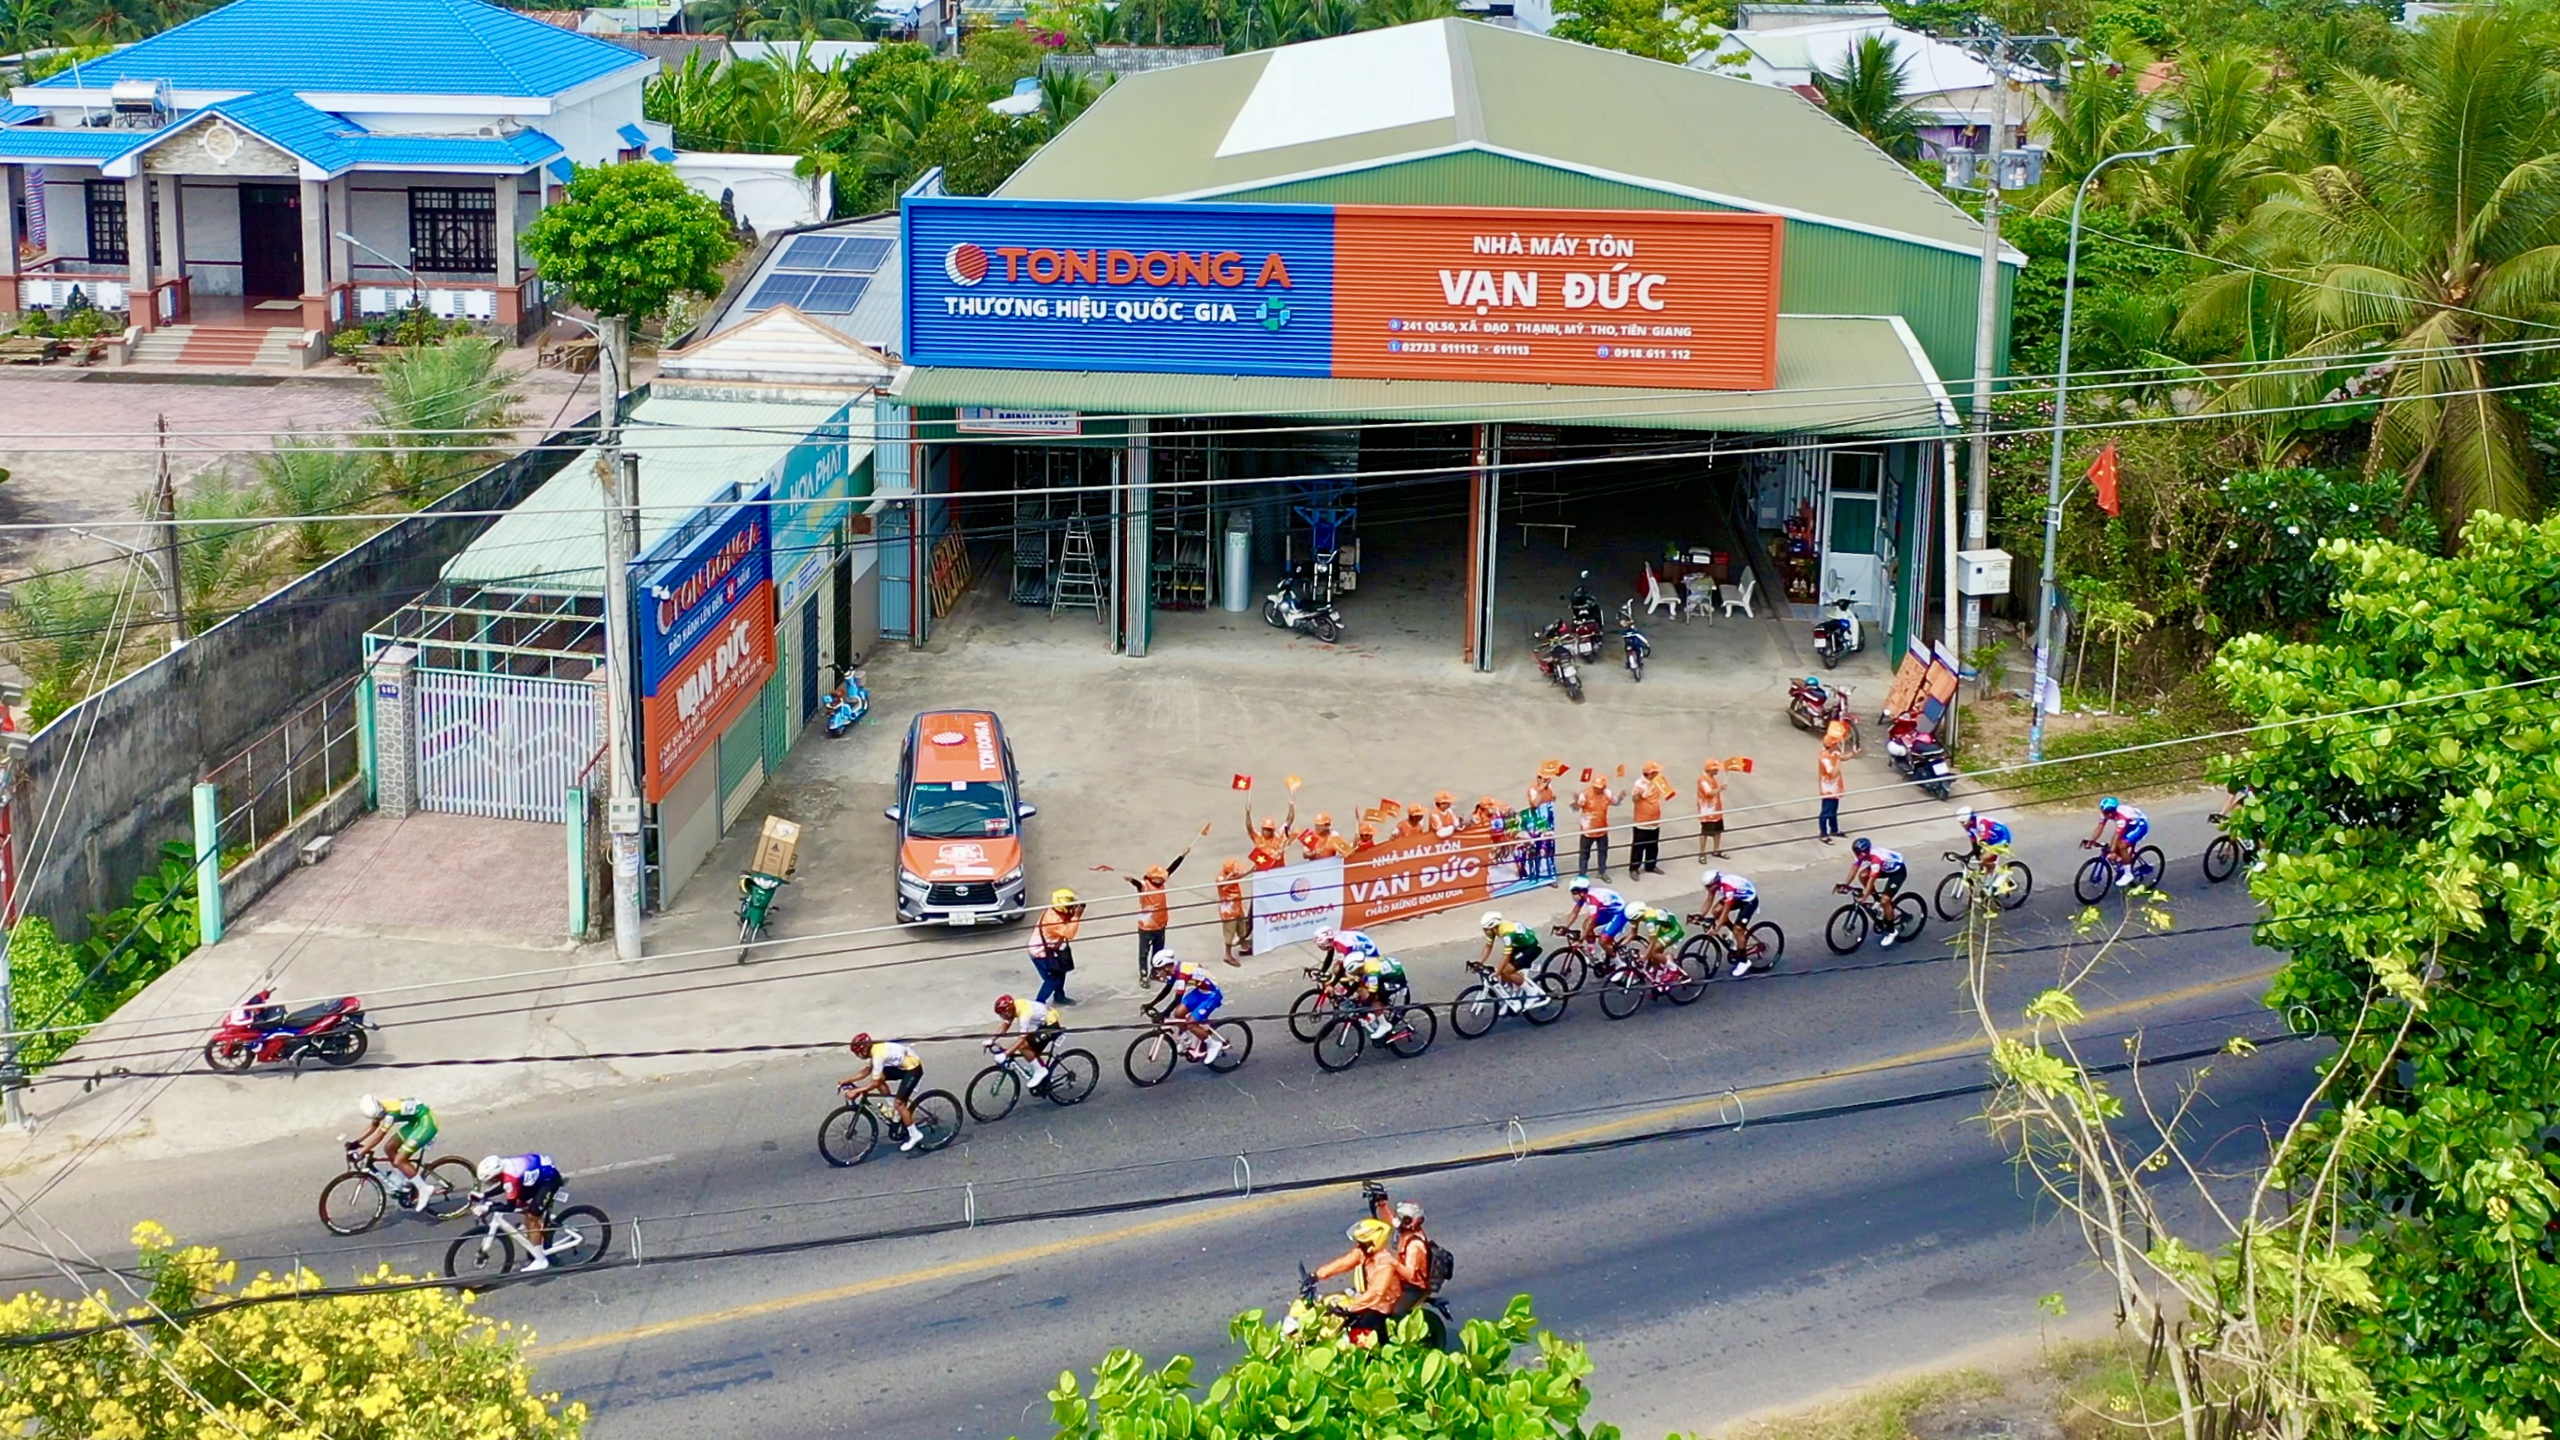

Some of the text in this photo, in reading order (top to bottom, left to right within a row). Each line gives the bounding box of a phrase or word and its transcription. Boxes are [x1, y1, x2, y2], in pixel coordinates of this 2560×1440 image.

[1473, 231, 1634, 257] NHÀ MÁY TÔN
[996, 247, 1293, 288] TON DONG A
[1438, 262, 1667, 316] VẠN ĐỨC
[944, 295, 1237, 325] THƯƠNG HIỆU QUỐC GIA
[1402, 321, 1422, 331] 241
[1425, 321, 1458, 334] QL50,
[1459, 319, 1478, 332] XÃ
[1515, 323, 1562, 336] THẠNH,
[1564, 322, 1585, 334] MỸ
[1590, 325, 1618, 337] THO,
[1652, 326, 1692, 337] GIANG
[1402, 342, 1437, 353] 02733
[1440, 343, 1479, 354] 611112
[1493, 345, 1530, 355] 611113
[671, 566, 707, 621] TON
[706, 530, 750, 589] DONG
[748, 521, 761, 551] A
[675, 658, 713, 723] VẠN
[715, 618, 751, 684] ĐỨC
[979, 751, 996, 771] TON
[1371, 840, 1461, 868] NHÀ MÁY TÔN
[1349, 855, 1480, 905] VẠN ĐỨC
[1264, 911, 1288, 924] TON
[1365, 903, 1390, 917] CHÀO
[1390, 896, 1418, 913] MỪNG
